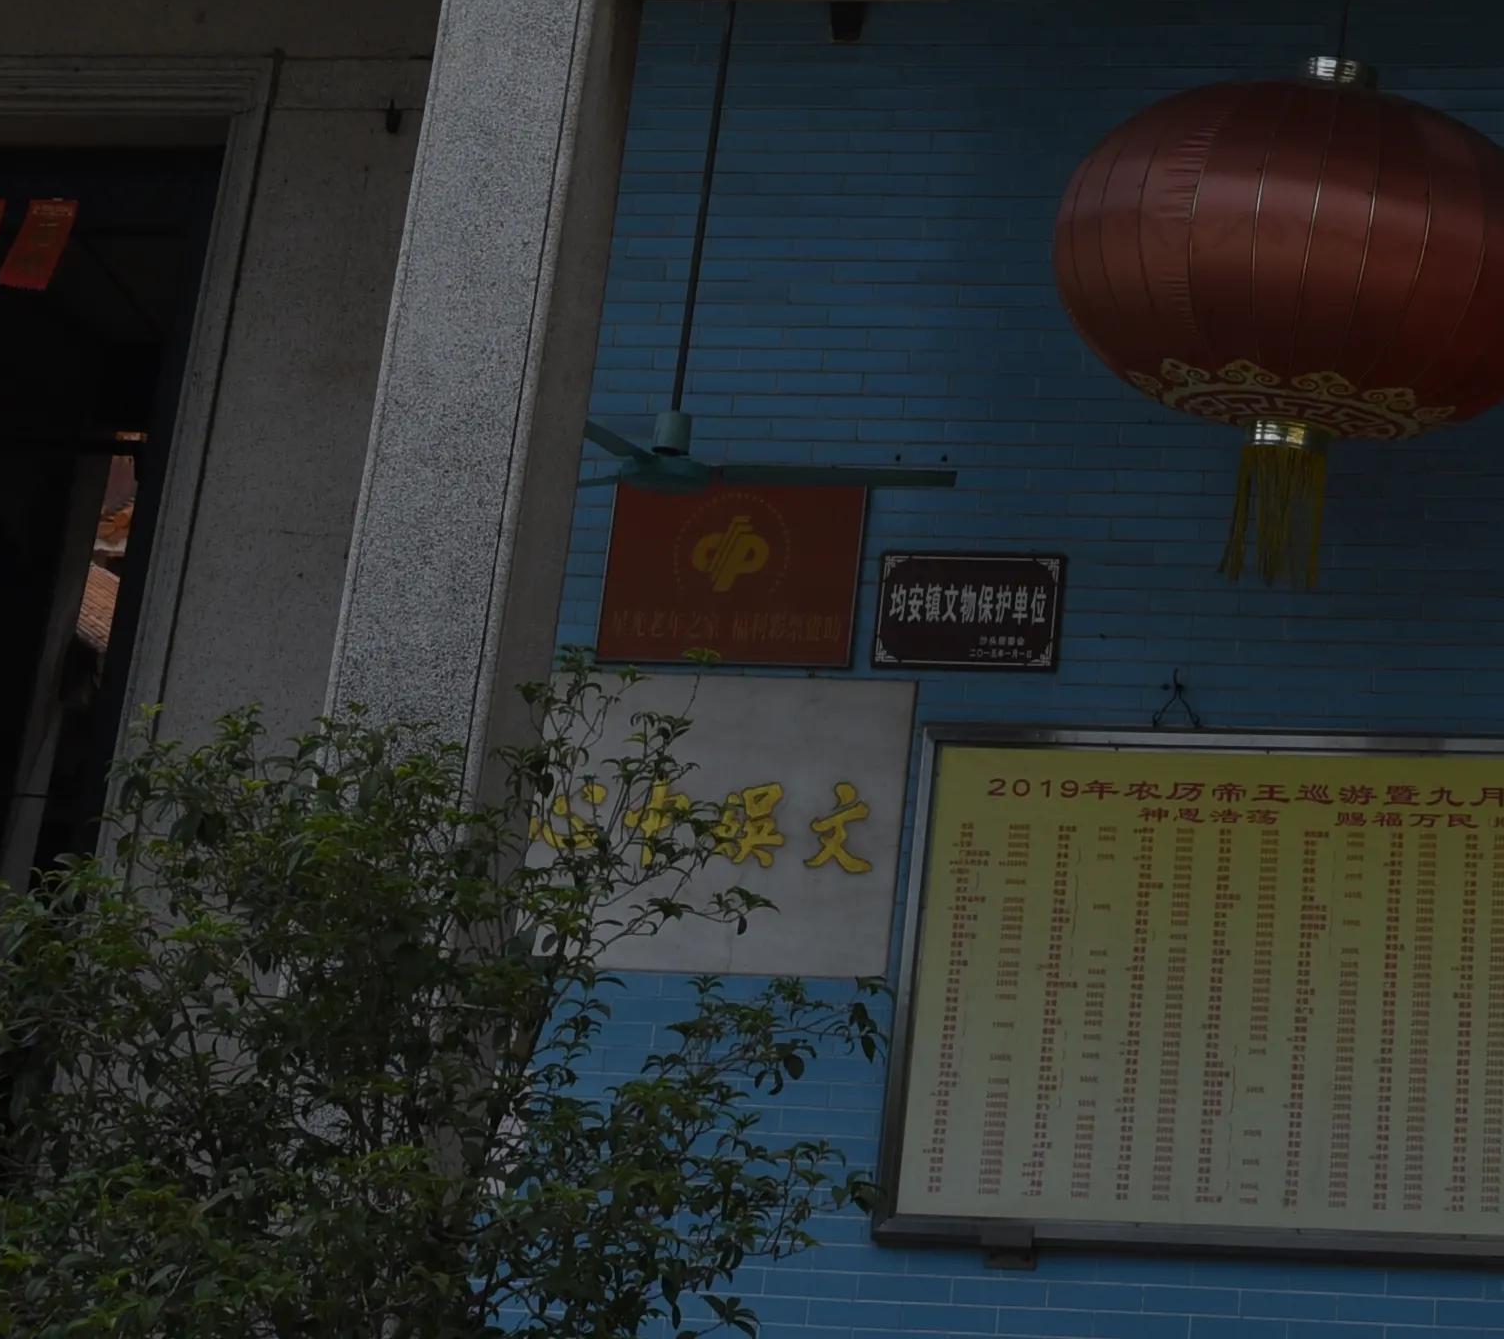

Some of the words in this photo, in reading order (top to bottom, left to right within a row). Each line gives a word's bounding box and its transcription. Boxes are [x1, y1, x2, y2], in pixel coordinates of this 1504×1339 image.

[888, 582, 1048, 626] 均安镇文物保护单位
[1138, 807, 1279, 824] 神恩浩荡
[1335, 812, 1479, 829] 赐福万民
